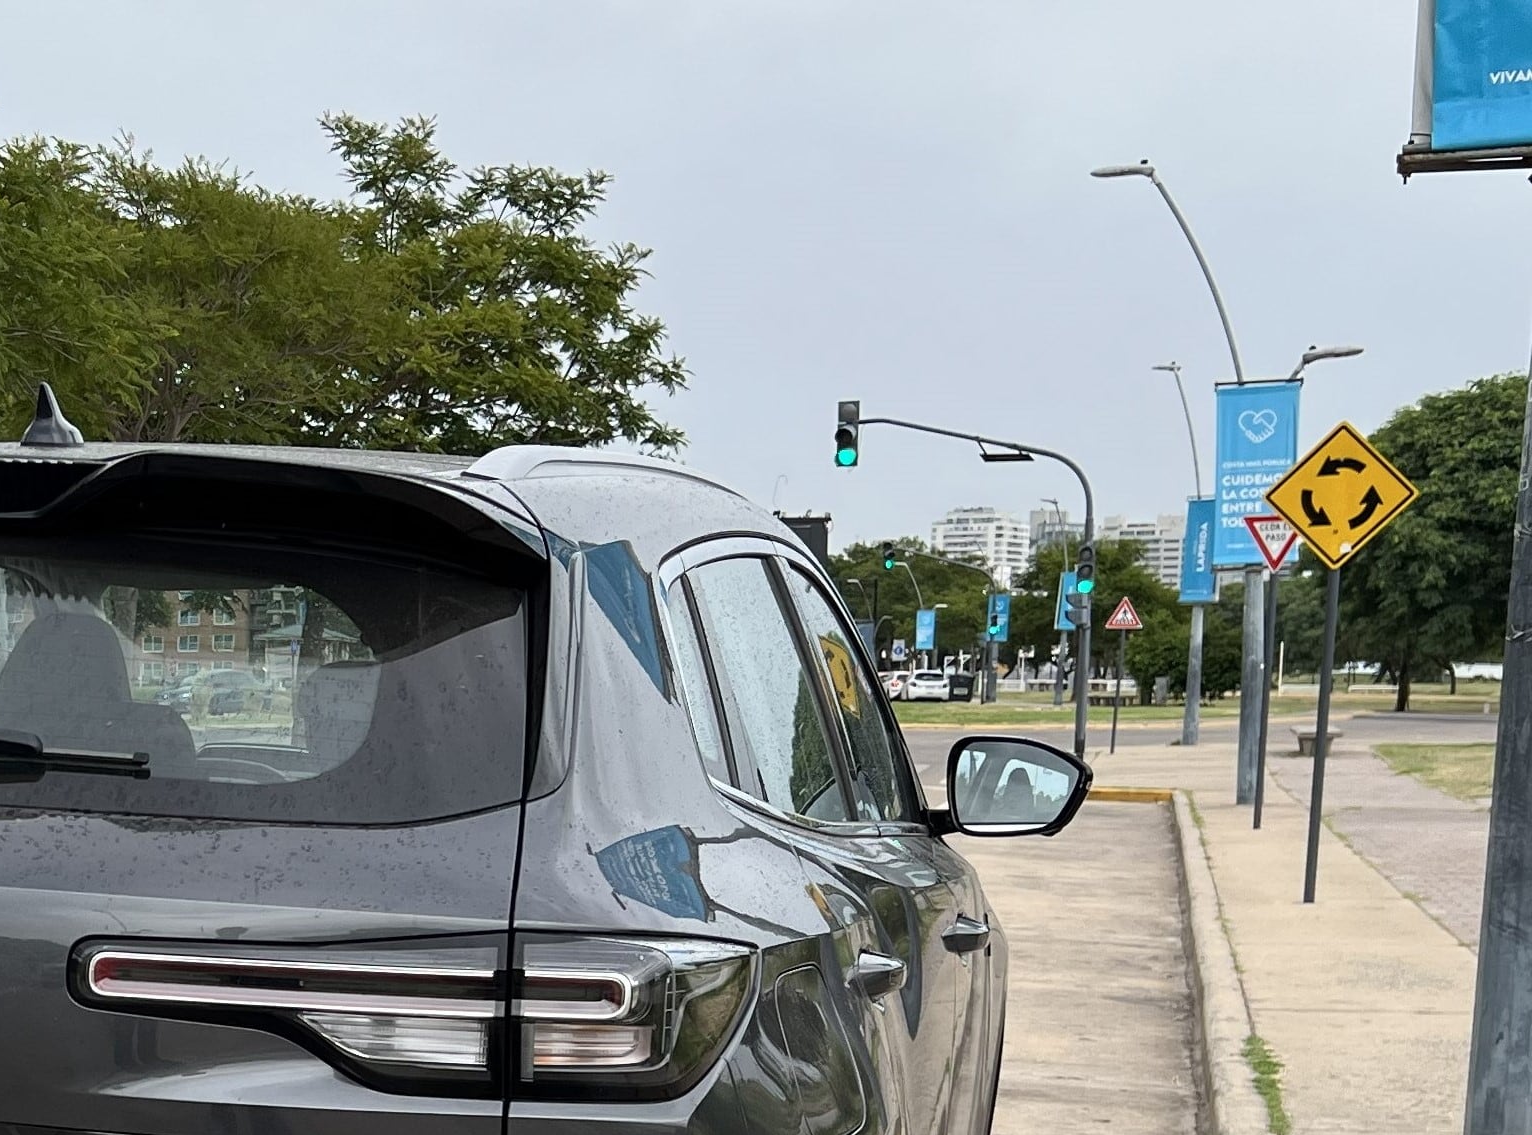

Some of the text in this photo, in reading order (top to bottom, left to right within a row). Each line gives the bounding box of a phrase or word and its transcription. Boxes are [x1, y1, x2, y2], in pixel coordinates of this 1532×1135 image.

[1222, 473, 1284, 487] CUIDEMO
[1222, 489, 1237, 500] LA
[1222, 502, 1262, 514] ENTRE
[1265, 533, 1287, 541] PASO
